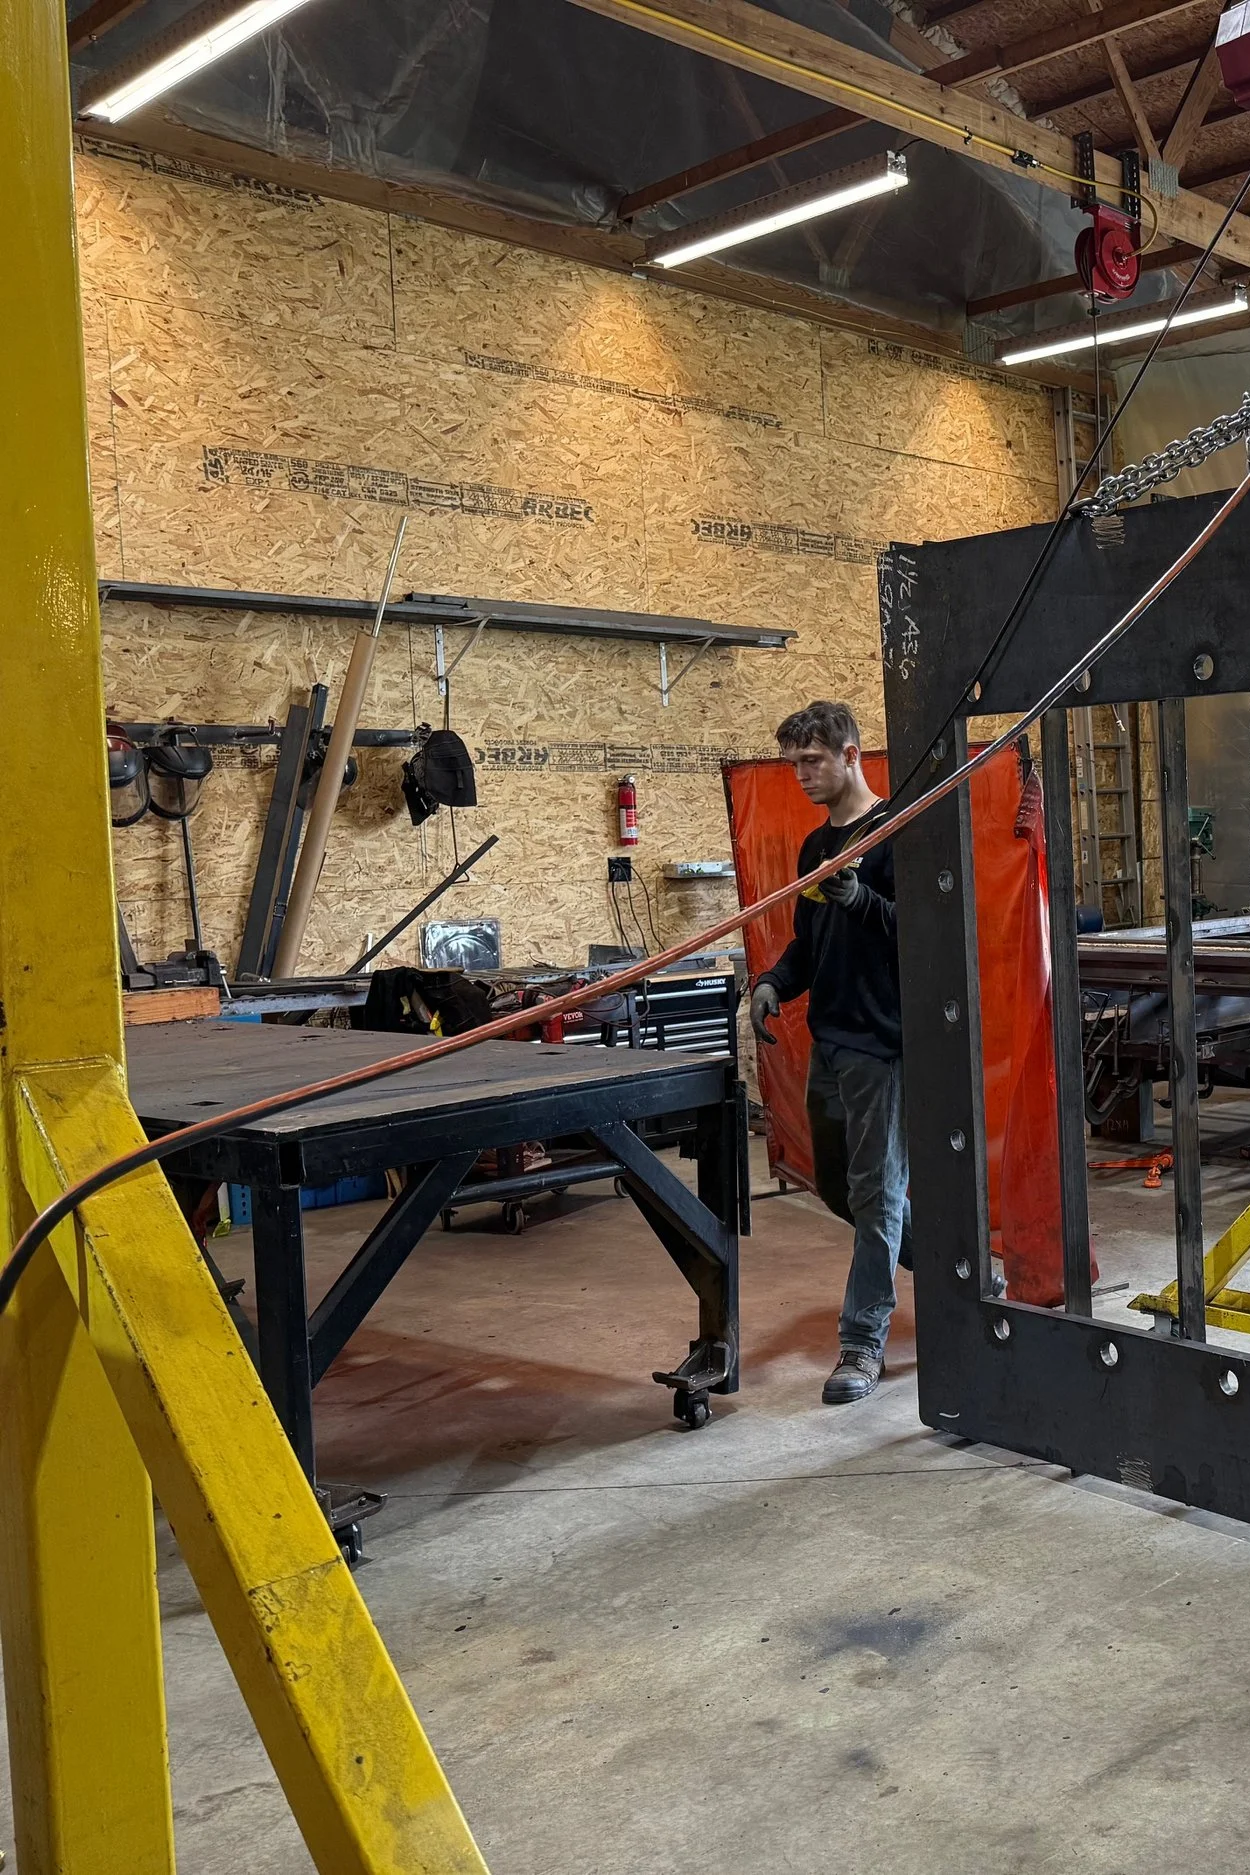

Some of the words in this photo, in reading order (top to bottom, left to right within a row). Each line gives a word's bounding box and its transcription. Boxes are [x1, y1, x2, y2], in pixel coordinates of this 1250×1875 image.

[474, 746, 549, 765] ARBEC
[703, 978, 726, 987] HUSKY
[563, 1011, 583, 1021] VEVOR
